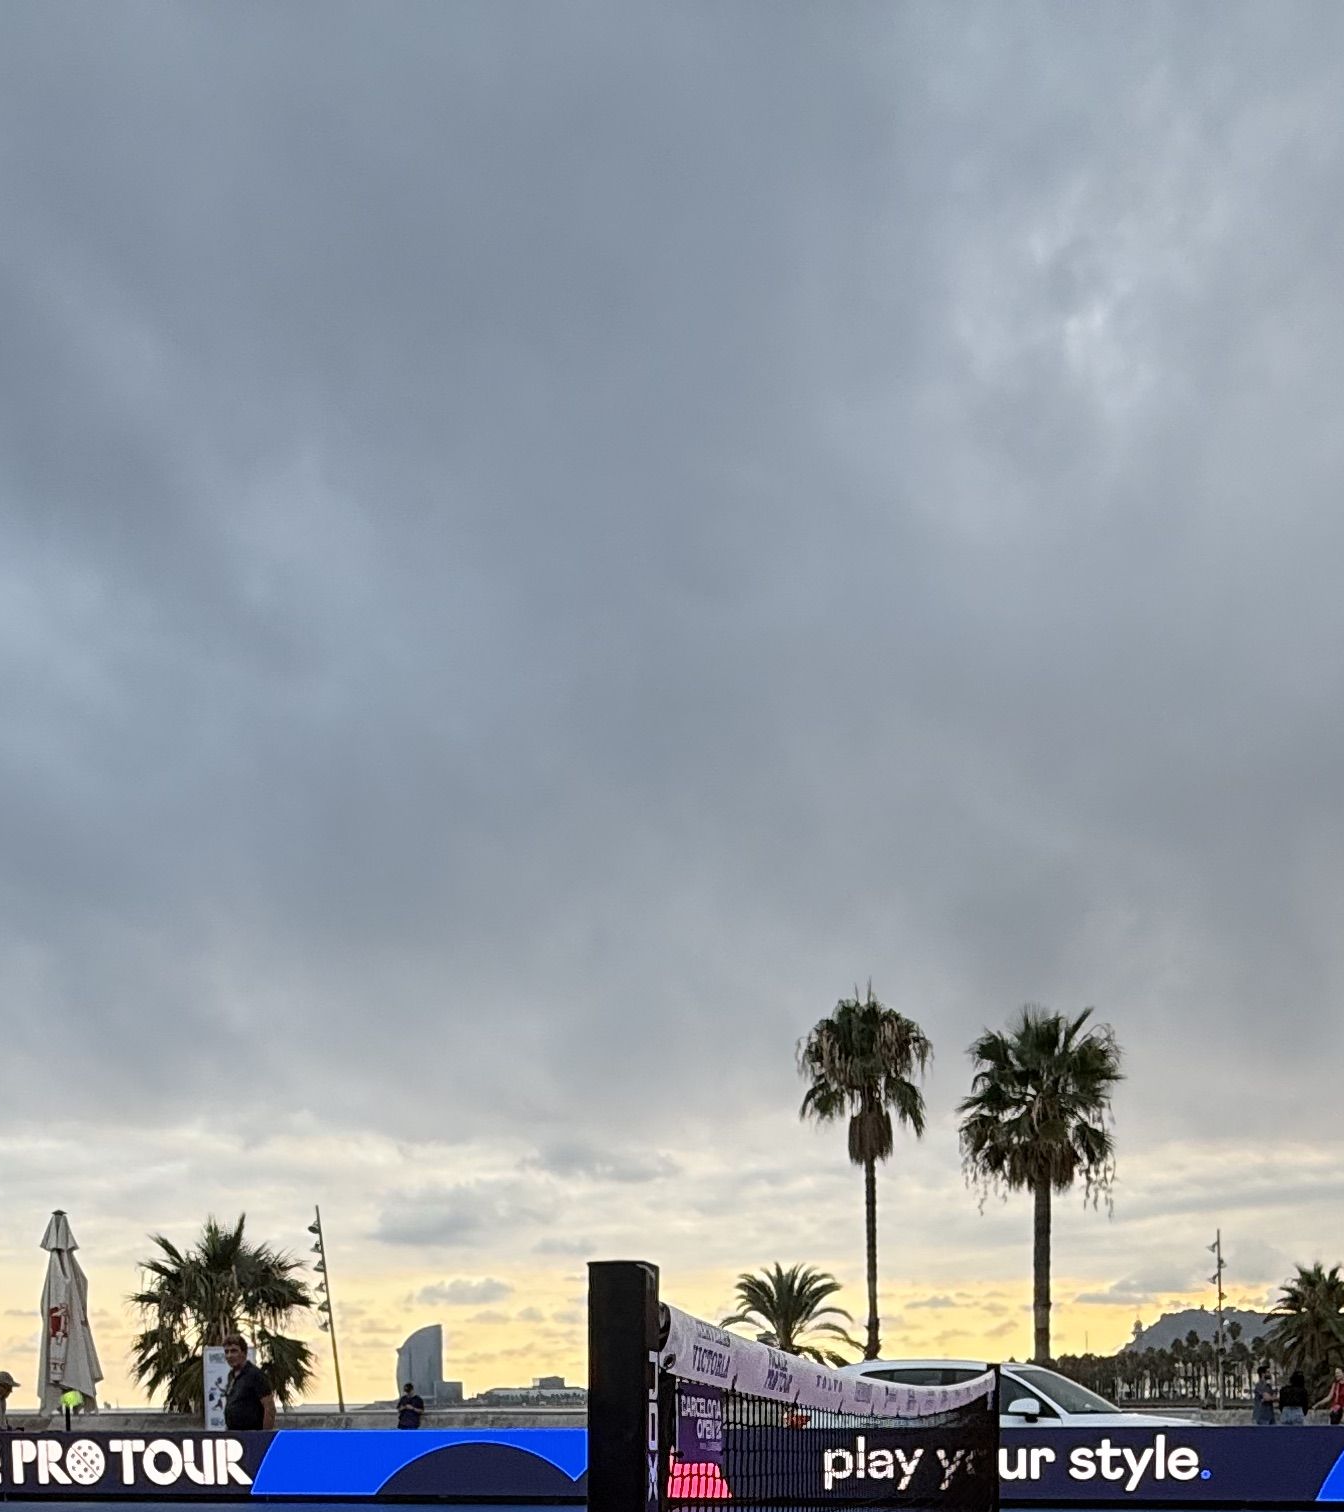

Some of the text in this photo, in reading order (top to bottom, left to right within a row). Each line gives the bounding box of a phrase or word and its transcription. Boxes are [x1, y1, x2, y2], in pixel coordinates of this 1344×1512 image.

[109, 1439, 254, 1486] TOUR
[823, 1434, 1212, 1492] play yur style.
